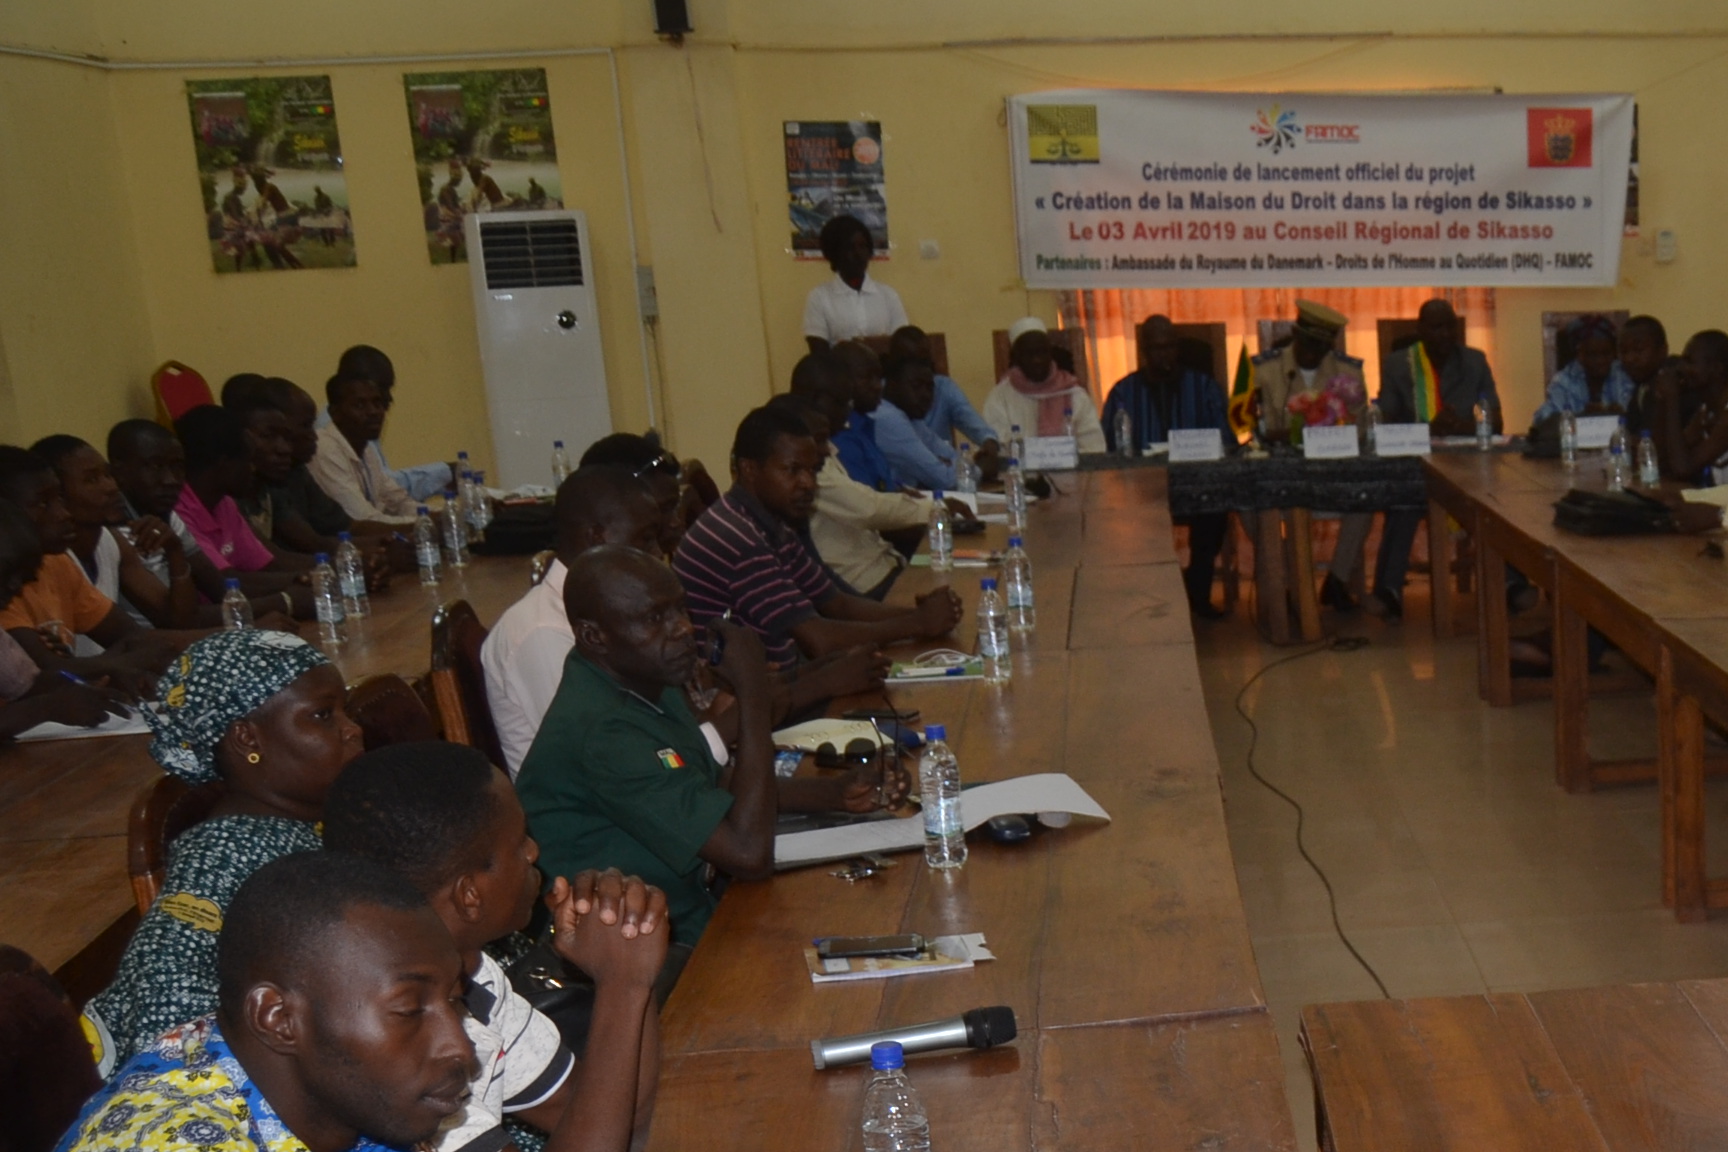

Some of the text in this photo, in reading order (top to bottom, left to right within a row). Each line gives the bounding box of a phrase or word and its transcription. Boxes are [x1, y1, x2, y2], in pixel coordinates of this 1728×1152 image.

[1304, 124, 1361, 139] FAMOC
[1142, 163, 1475, 186] Cérémonie de lancement officiel du projet
[1052, 191, 1132, 210] Création
[1138, 191, 1160, 210] de
[1167, 191, 1183, 210] la
[1190, 191, 1256, 210] Maison
[1263, 191, 1284, 210] du
[1291, 191, 1336, 210] Droit
[1342, 191, 1386, 210] dans
[1392, 191, 1408, 210] la
[1414, 191, 1471, 214] région
[1478, 191, 1499, 210] de
[1506, 191, 1576, 210] Sikasso
[1069, 221, 1554, 244] Le 03 Avril 2019 au Conseil Régional de Sikasso
[1036, 254, 1101, 271] Partenaires
[1111, 254, 1176, 271] Ambassade
[1179, 254, 1193, 270] du
[1196, 254, 1247, 274] Royaume
[1250, 254, 1264, 270] du
[1268, 254, 1324, 270] Danemark
[1336, 254, 1368, 270] Droits
[1372, 254, 1385, 269] de
[1439, 254, 1453, 269] au
[1456, 254, 1508, 271] Quotidien
[1511, 254, 1544, 272] (DHQ)
[1555, 254, 1594, 270] FAMOC
